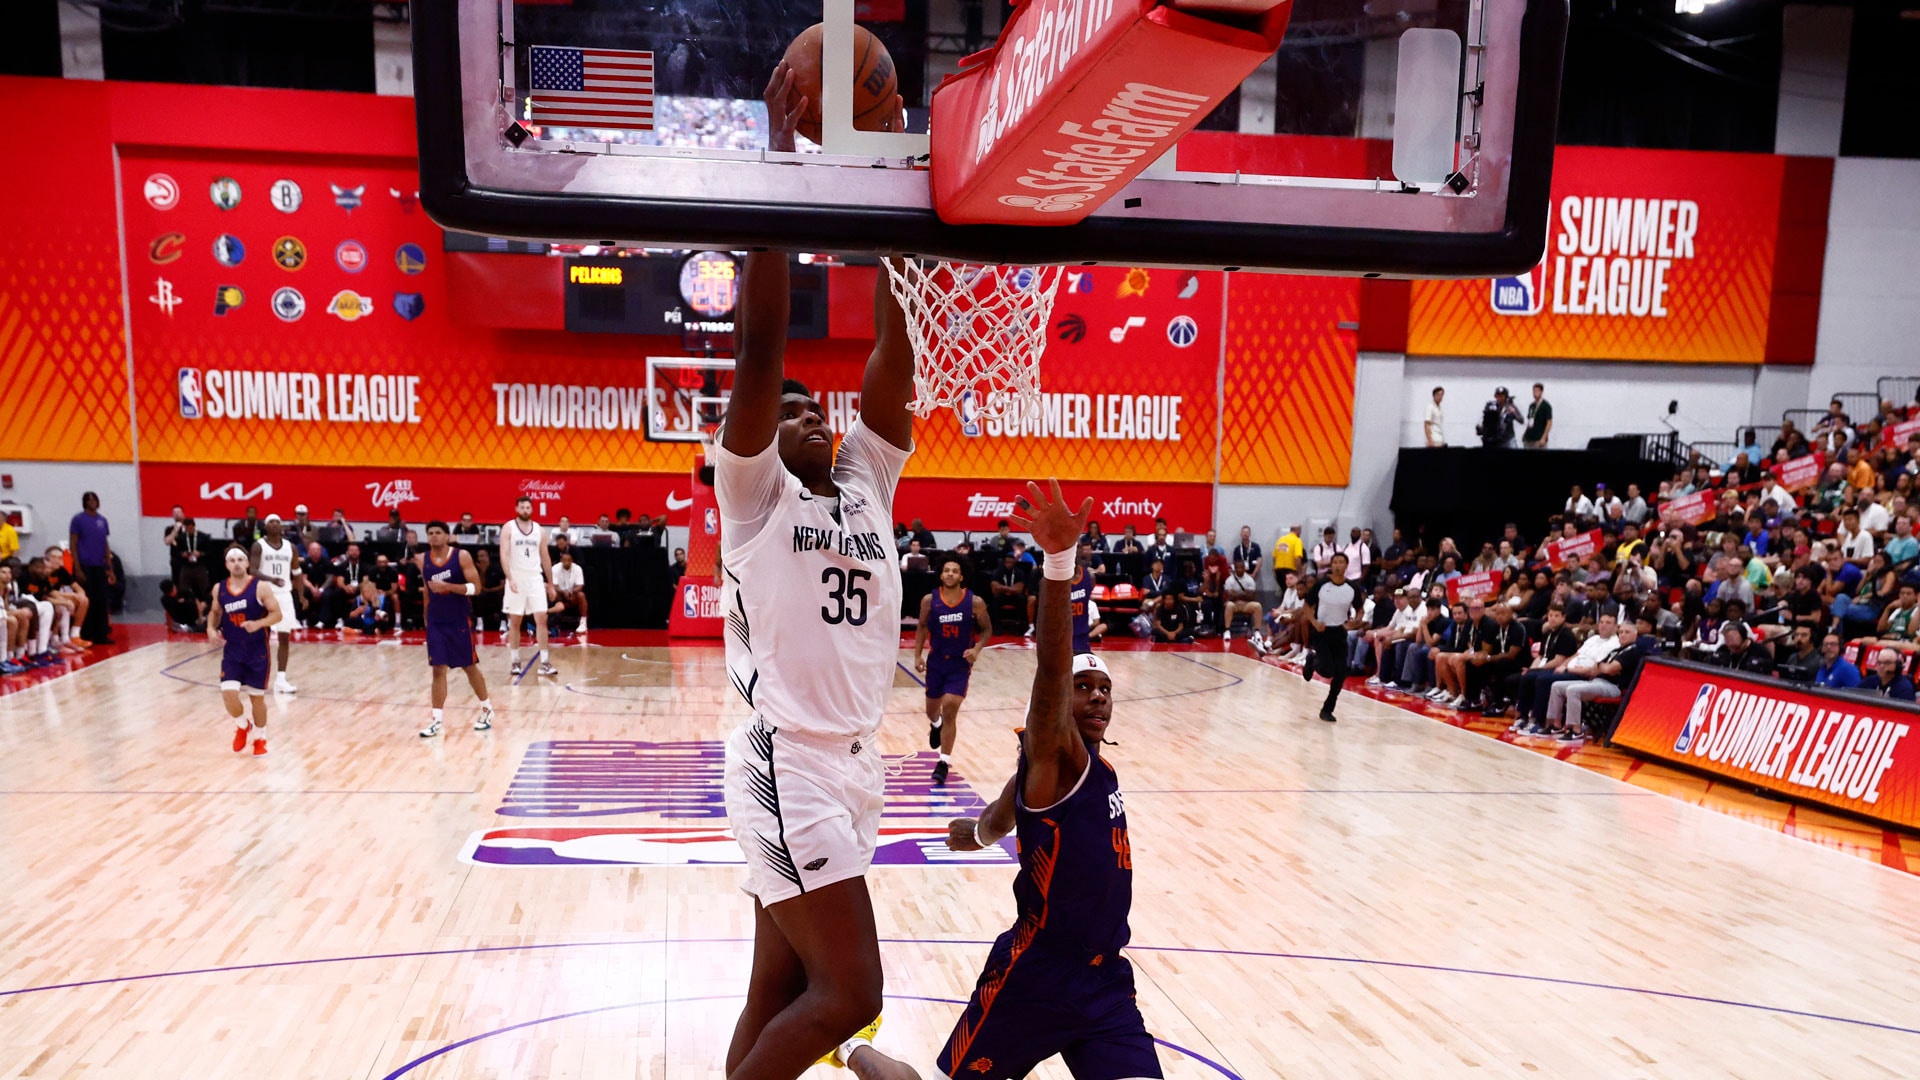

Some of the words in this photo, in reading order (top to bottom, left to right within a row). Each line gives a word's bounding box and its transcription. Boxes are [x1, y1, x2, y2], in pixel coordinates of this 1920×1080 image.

[1557, 195, 1699, 258] SUMMER
[570, 266, 622, 284] PELICANS
[1067, 271, 1093, 293] 76
[1552, 256, 1672, 317] LEAGUE
[1499, 286, 1523, 307] NBA
[205, 369, 321, 421] SUMMER
[326, 373, 421, 423] LEAGUE
[492, 383, 666, 433] TOMORROW'S
[986, 391, 1090, 439] SUMMER
[1096, 393, 1182, 440] LEAGUE
[365, 482, 420, 509] Vegas
[1102, 496, 1163, 518] xfinity
[793, 526, 833, 552] NEW
[273, 563, 283, 575] 10
[224, 599, 248, 613] SUNS
[821, 567, 871, 626] 35
[1071, 588, 1086, 600] UNS
[938, 612, 963, 623] SUNS
[942, 624, 959, 638] 54
[1695, 688, 1811, 780] SUMMER
[1788, 708, 1910, 804] LEAGUE
